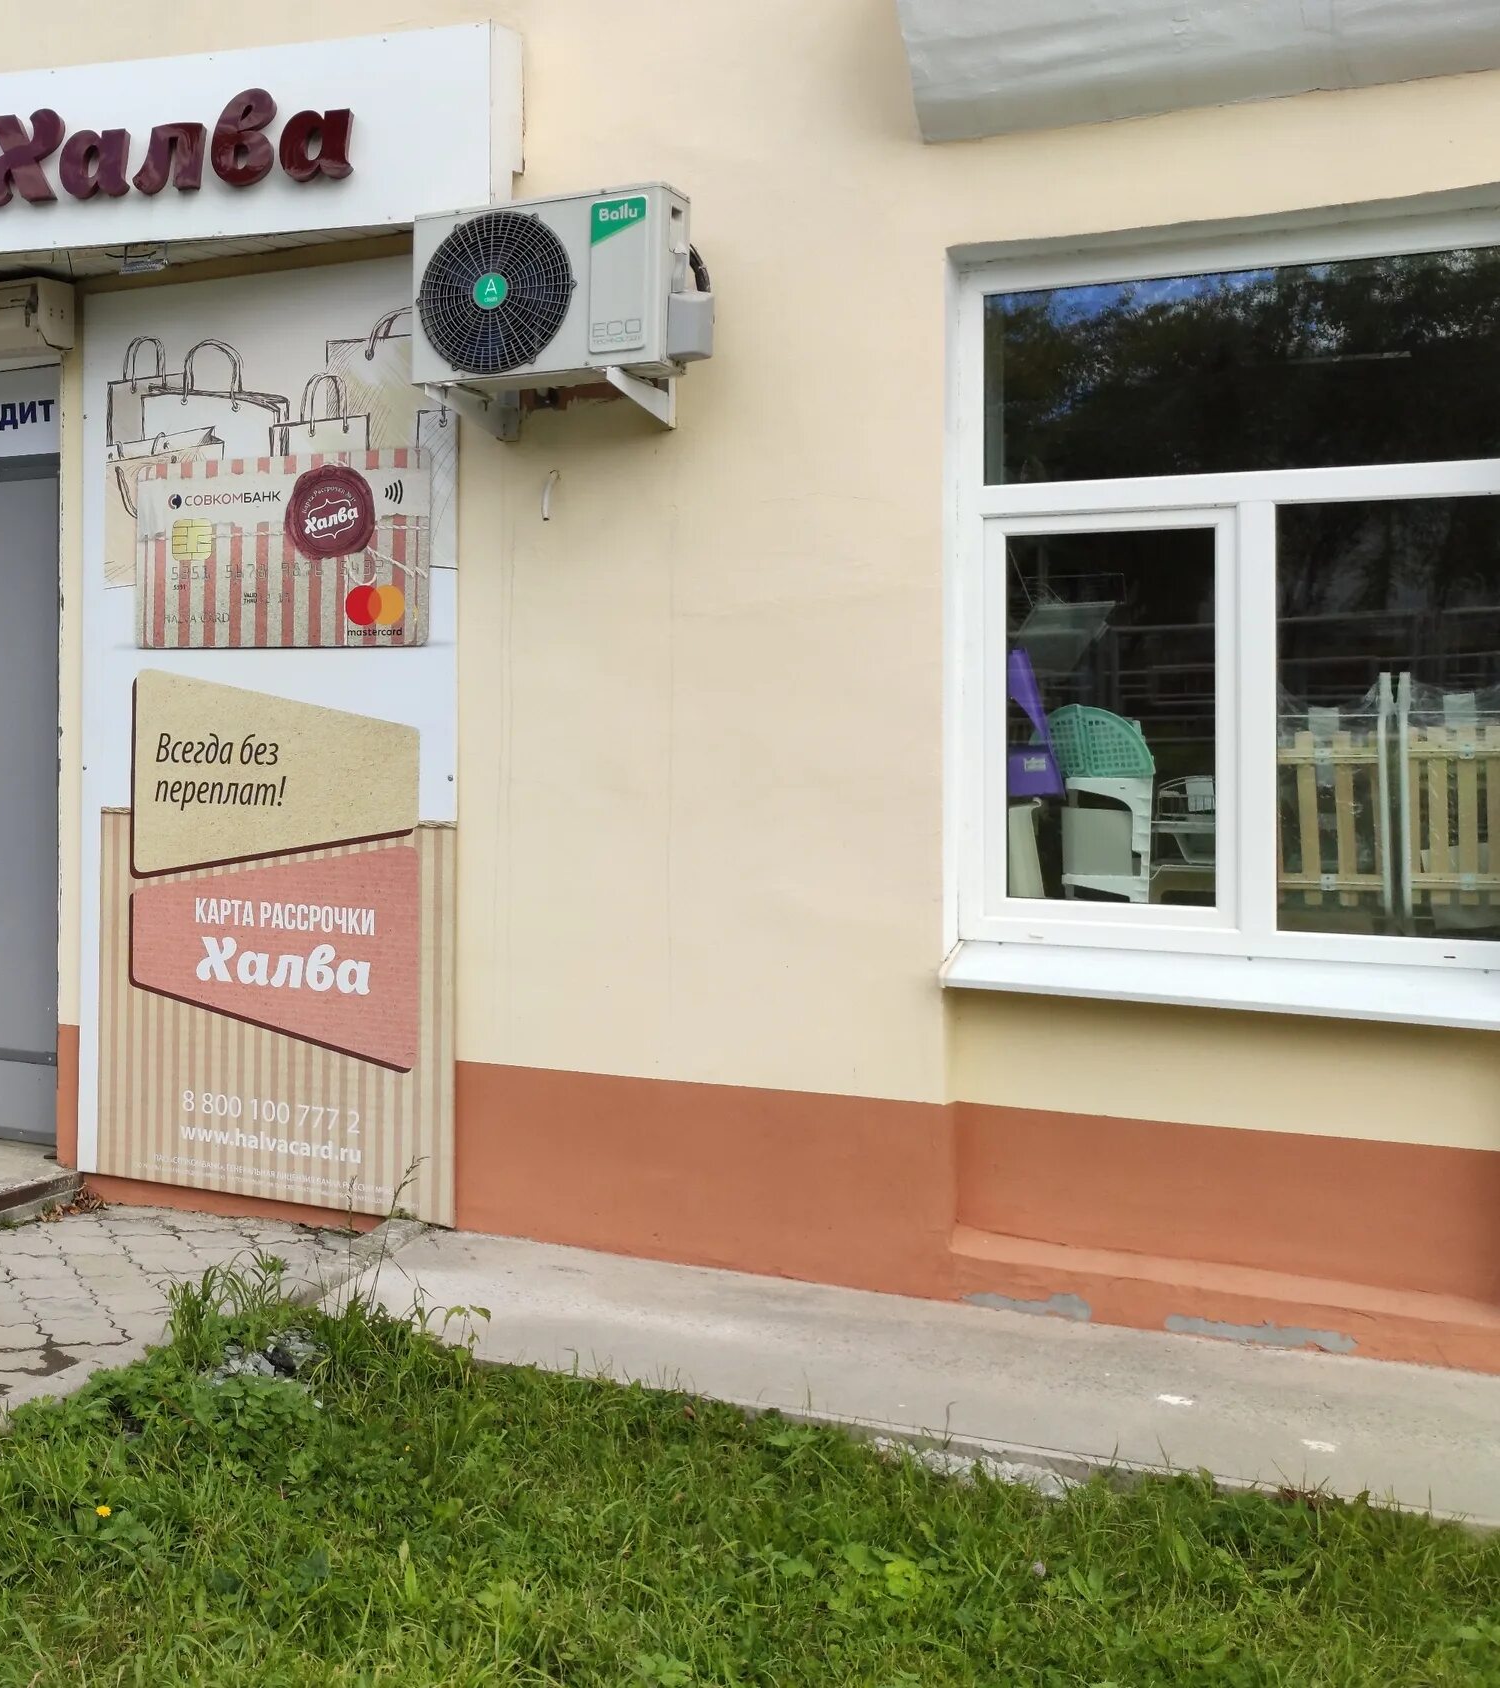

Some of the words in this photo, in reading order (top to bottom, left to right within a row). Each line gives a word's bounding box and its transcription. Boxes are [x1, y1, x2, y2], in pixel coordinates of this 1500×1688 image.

[598, 202, 638, 221] Ballu
[485, 279, 497, 295] A
[593, 319, 641, 337] ECO
[184, 490, 282, 507] СОВКОМБАНК
[304, 506, 359, 534] Халва
[347, 627, 402, 637] mastercard
[156, 732, 234, 766] Всегда
[240, 734, 280, 766] без
[154, 776, 287, 811] переплат!
[196, 897, 254, 927] КАРТА
[260, 902, 376, 936] РАССРОЧКИ
[196, 936, 371, 996] Халва
[183, 1090, 195, 1112] 8
[202, 1094, 242, 1118] 800
[250, 1098, 290, 1124] 100
[297, 1104, 339, 1130] 777
[347, 1110, 360, 1134] 2
[180, 1124, 362, 1164] www.halvacard.ru
